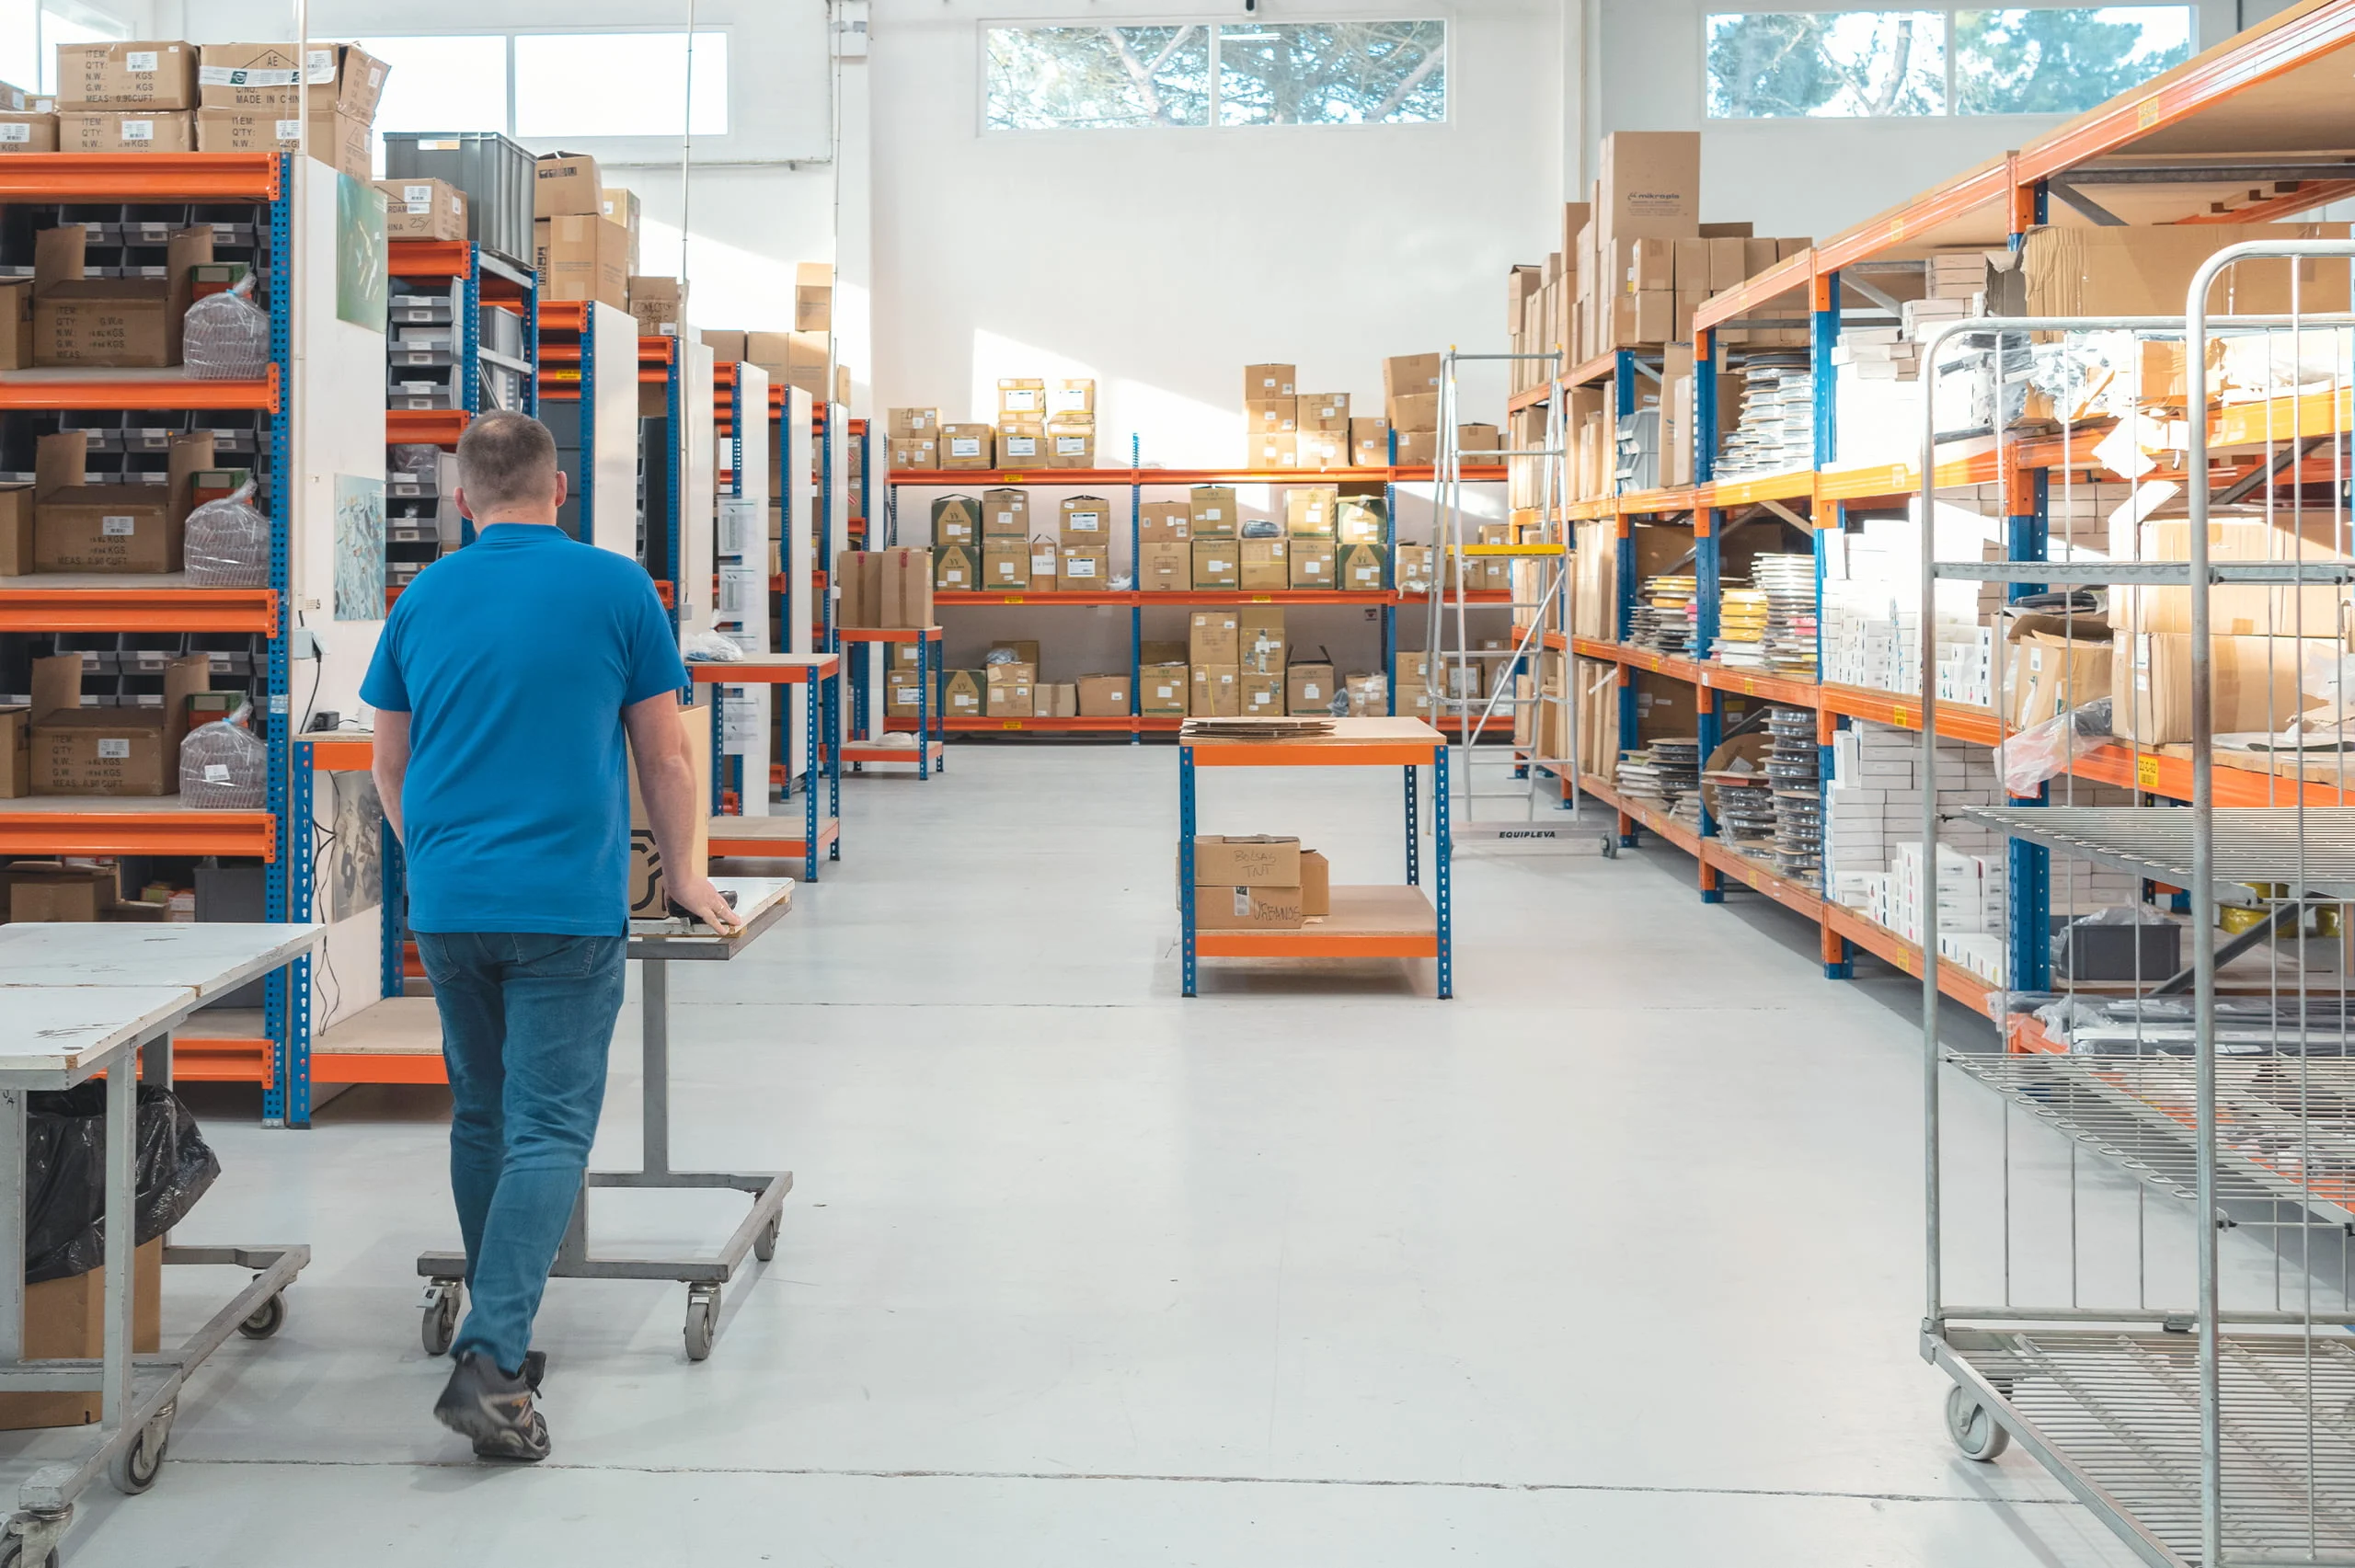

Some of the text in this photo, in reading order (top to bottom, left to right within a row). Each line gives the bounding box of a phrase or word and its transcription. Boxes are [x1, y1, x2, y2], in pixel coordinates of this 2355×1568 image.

[267, 56, 278, 67] AE
[236, 95, 261, 104] MADE
[267, 95, 275, 104] IN
[1499, 830, 1556, 839] EQUIPLEVA
[1242, 864, 1275, 877] TNT
